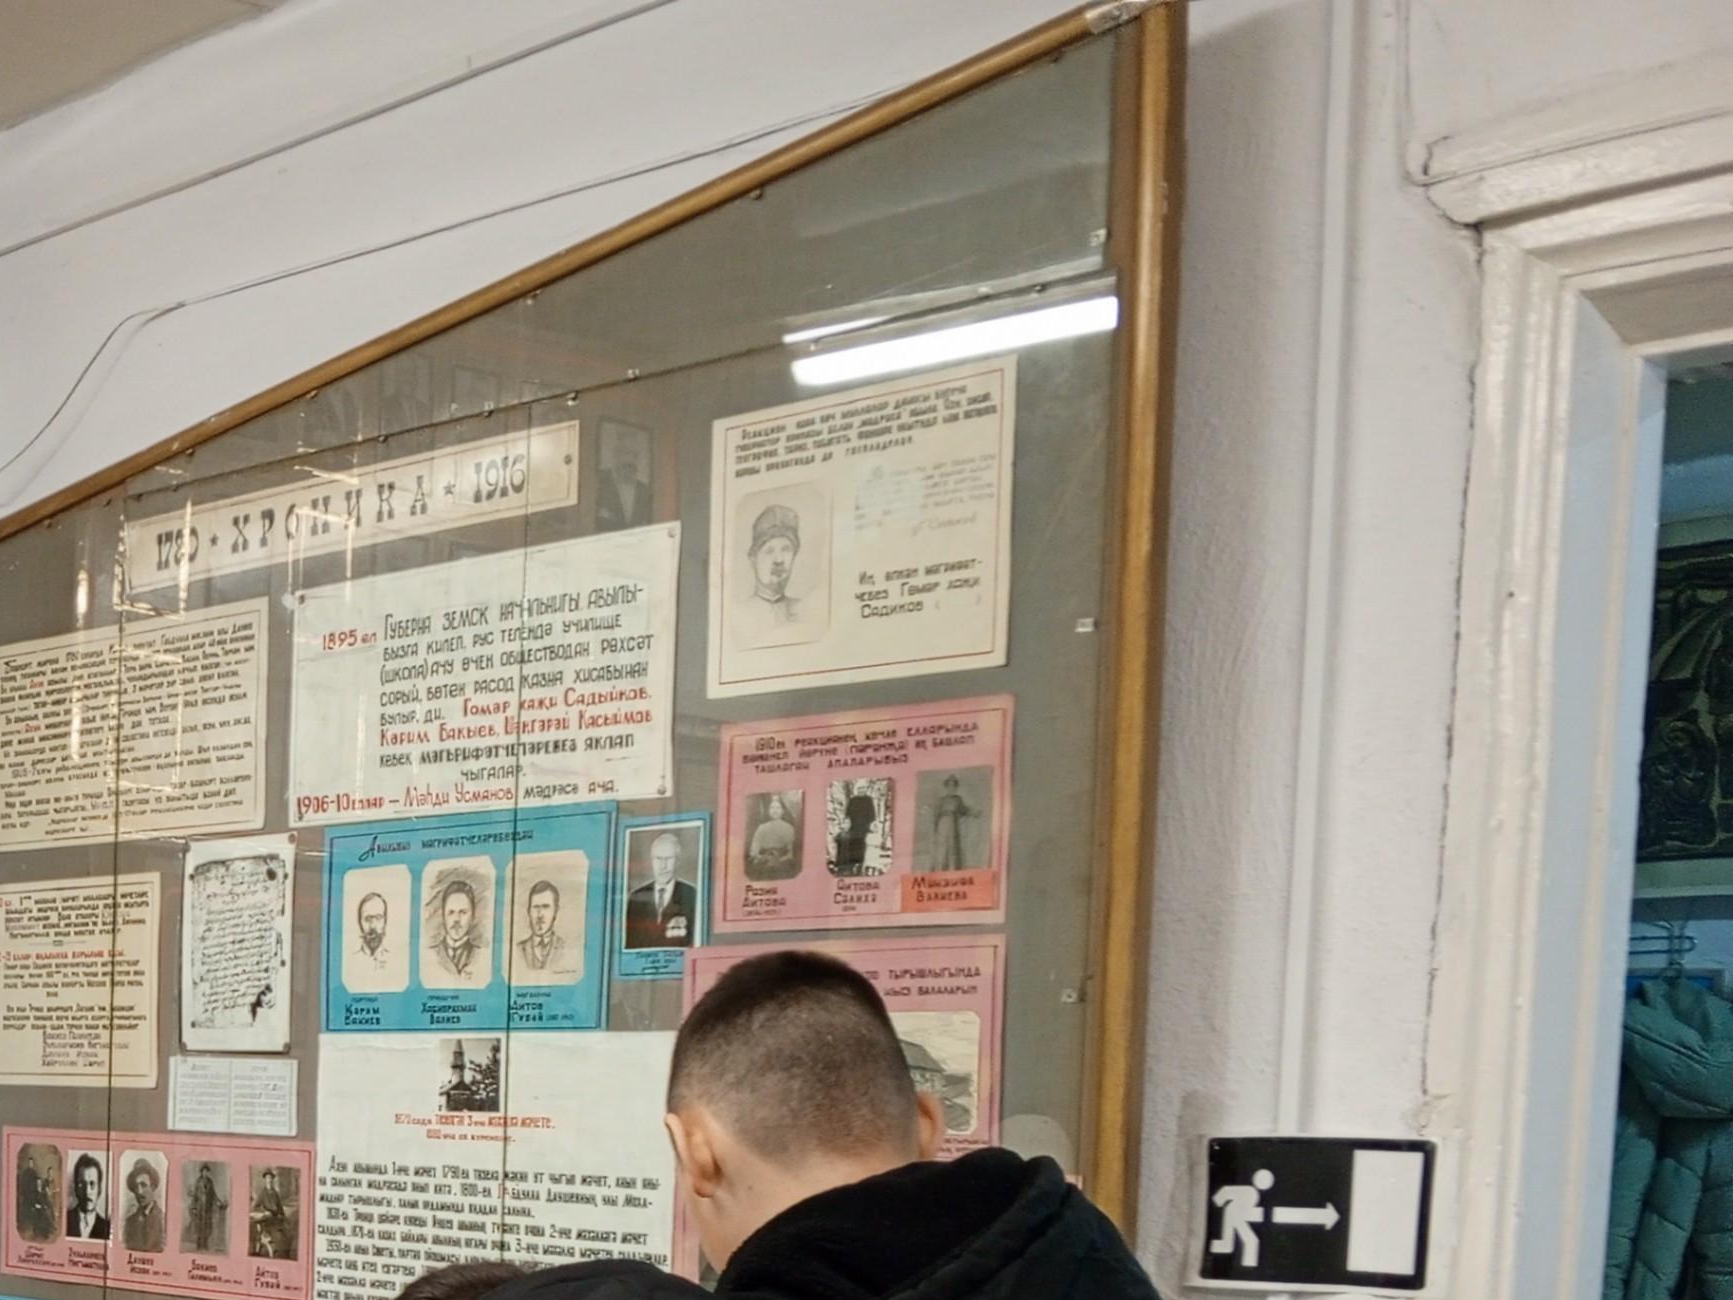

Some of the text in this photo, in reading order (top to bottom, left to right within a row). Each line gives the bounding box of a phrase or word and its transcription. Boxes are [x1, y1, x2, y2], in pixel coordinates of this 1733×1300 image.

[231, 475, 429, 554] ХРОНИКА
[473, 454, 526, 503] 1916
[323, 629, 357, 651] 1895
[472, 631, 494, 648] РУС
